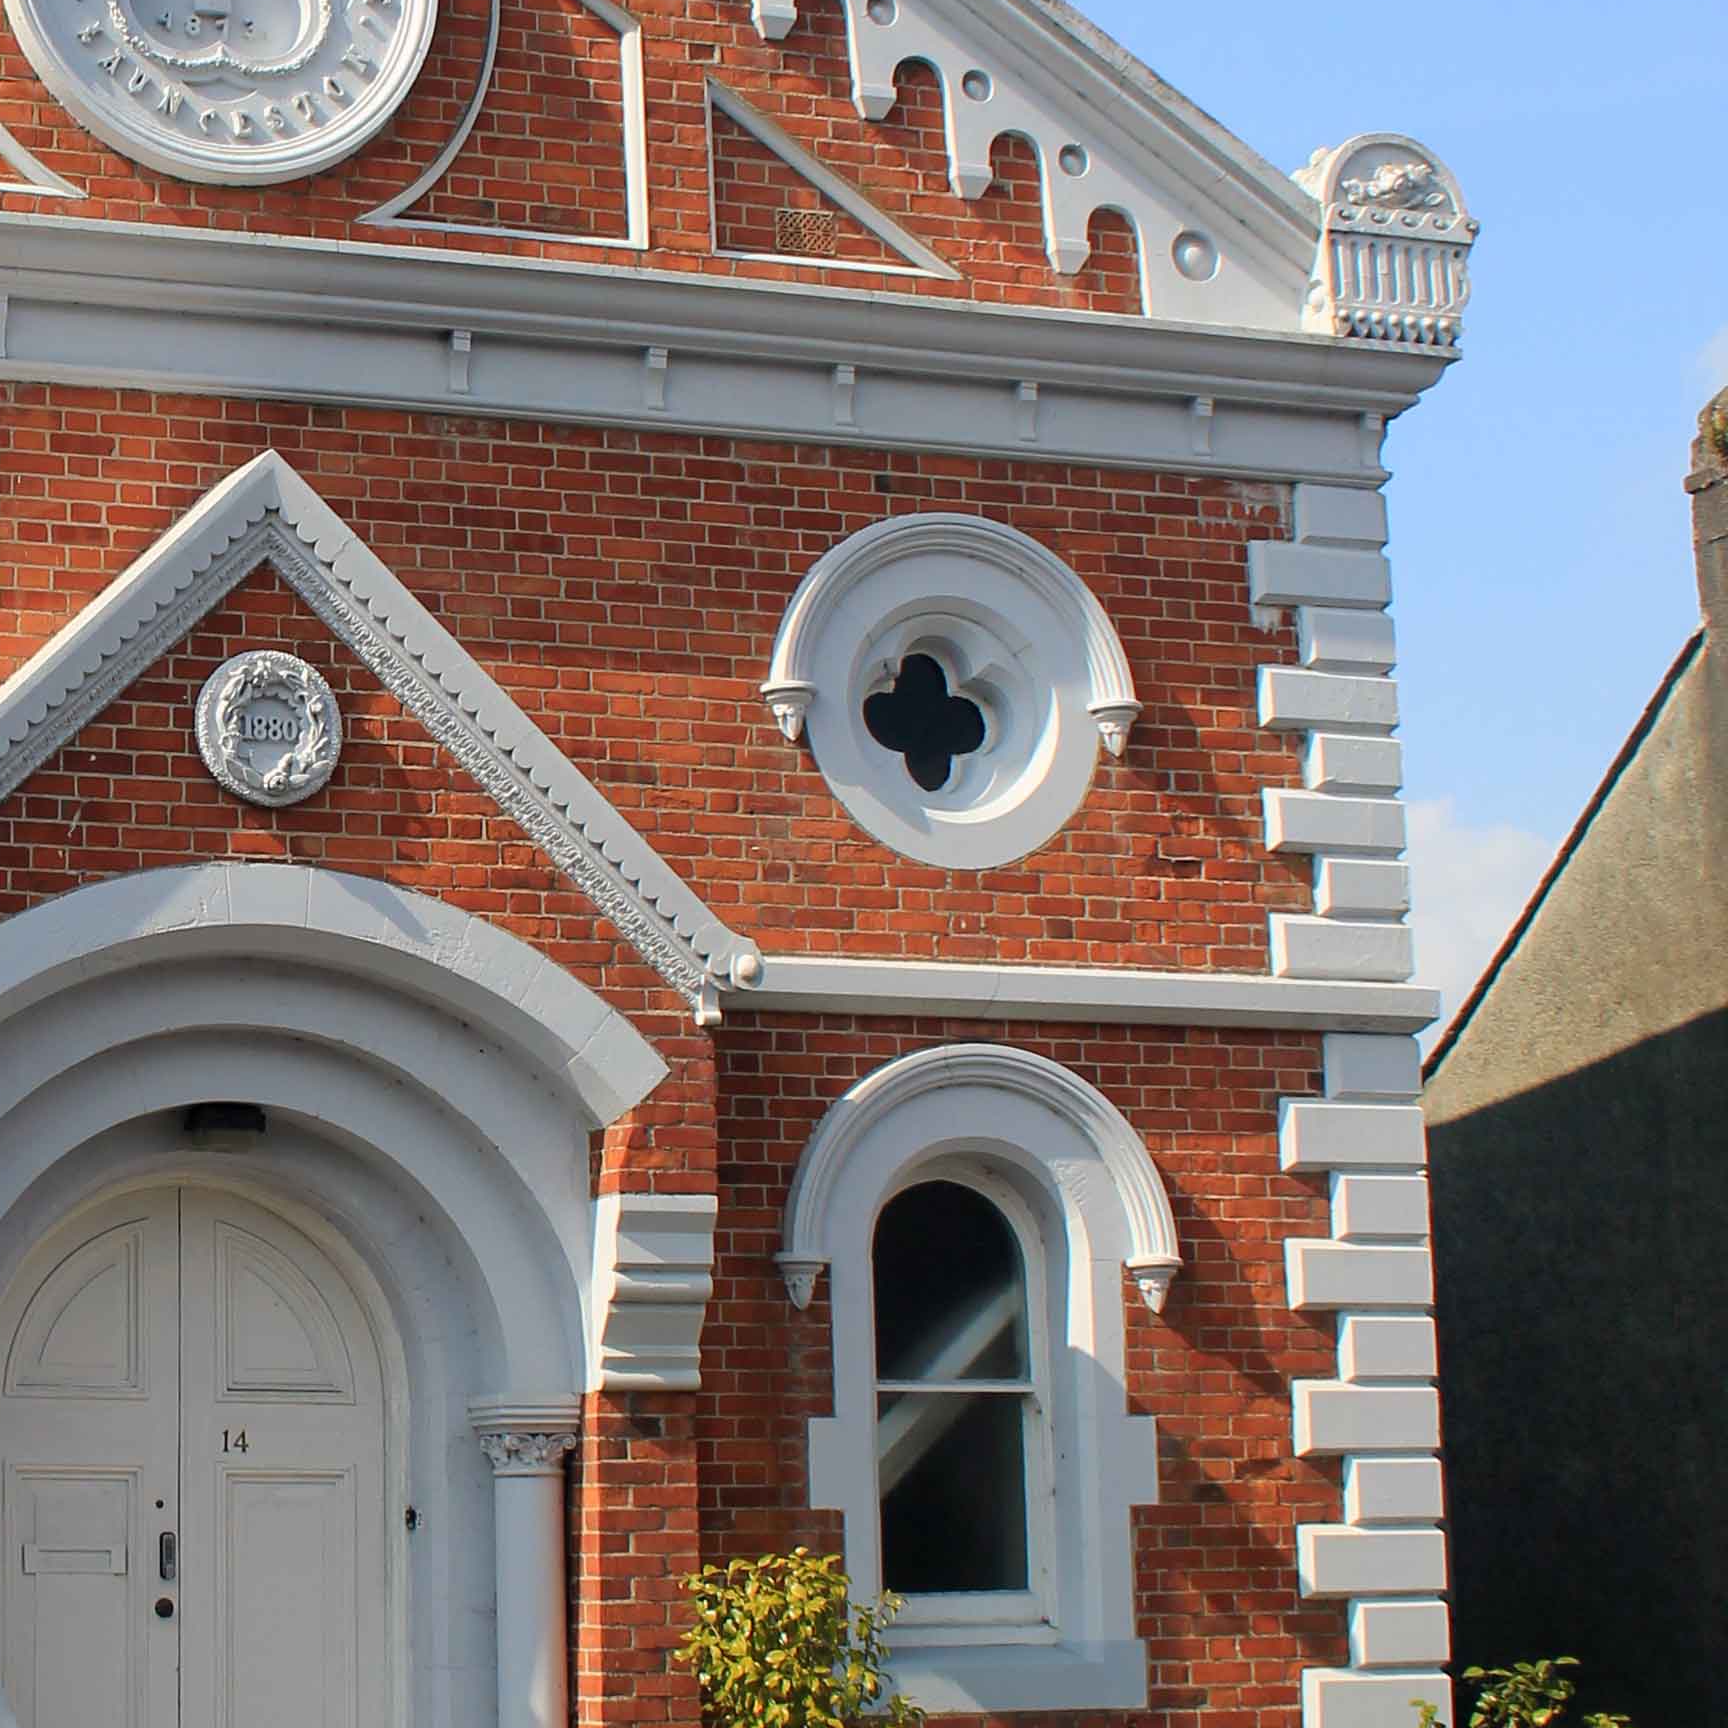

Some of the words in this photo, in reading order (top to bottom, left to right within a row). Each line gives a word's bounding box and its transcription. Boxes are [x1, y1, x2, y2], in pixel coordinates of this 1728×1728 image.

[77, 22, 370, 139] LAUNCESTON
[240, 715, 299, 743] 1880
[221, 1428, 250, 1454] 14
